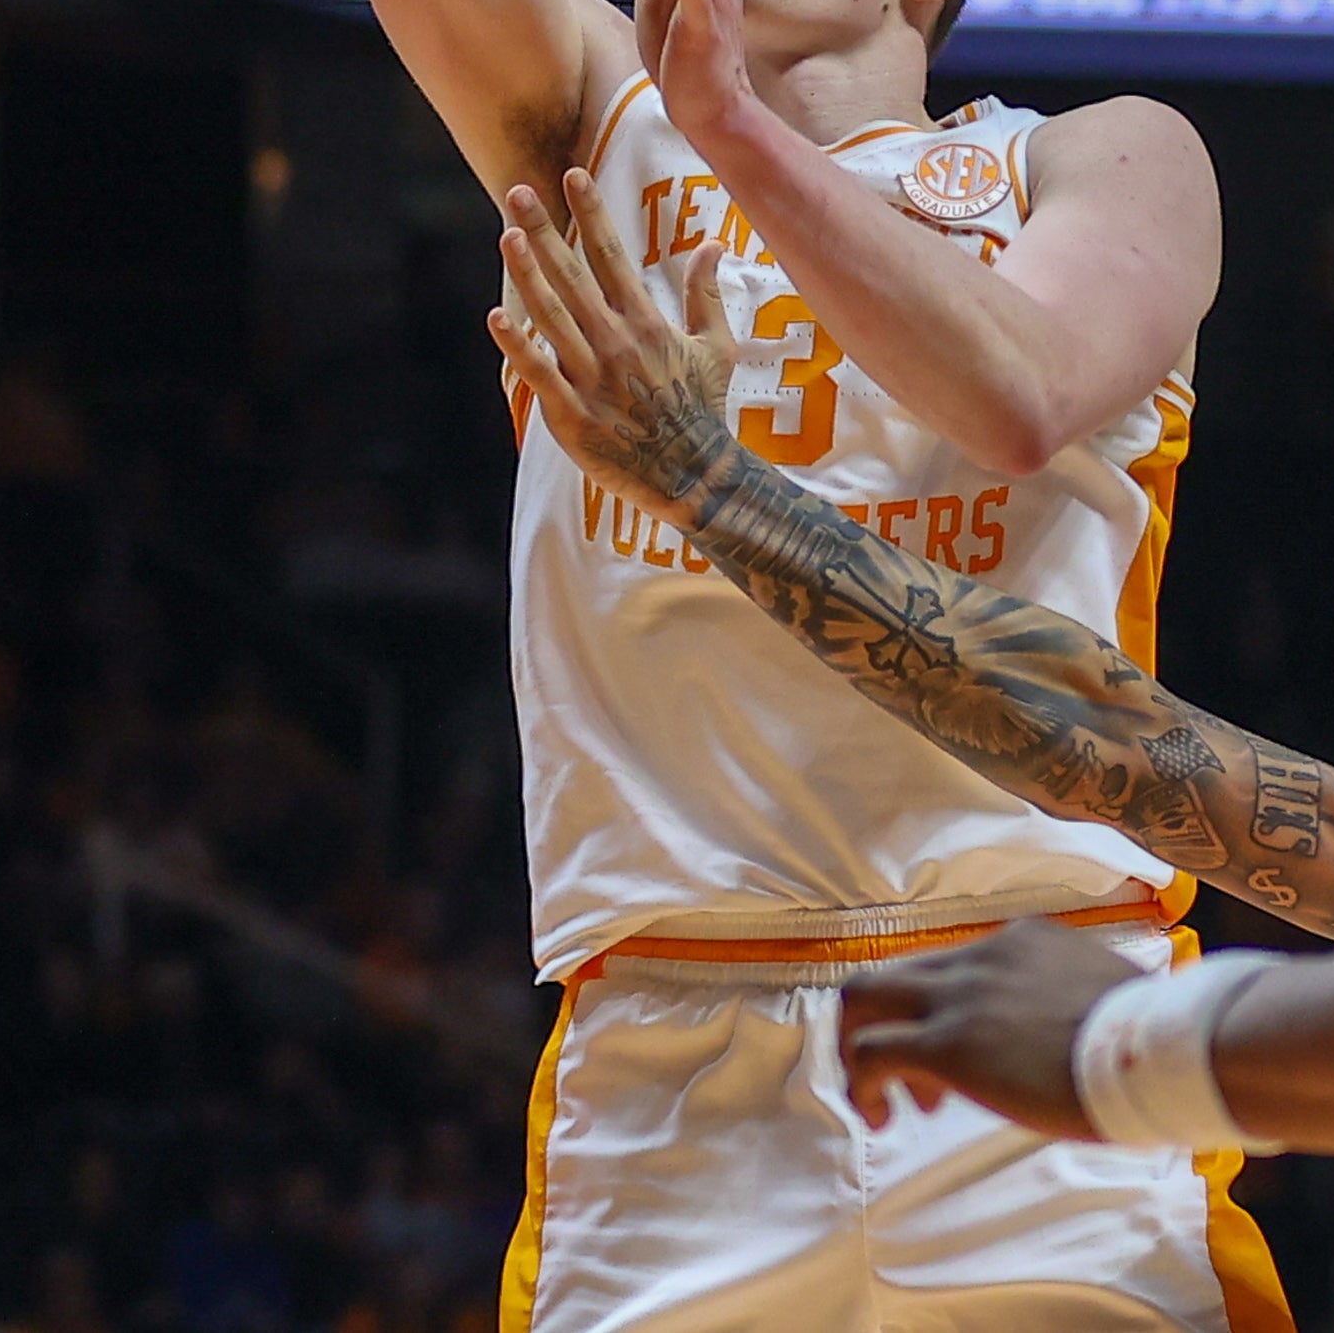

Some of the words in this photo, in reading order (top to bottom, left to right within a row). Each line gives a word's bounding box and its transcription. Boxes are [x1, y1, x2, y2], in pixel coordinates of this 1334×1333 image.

[925, 146, 994, 198] SEC
[909, 186, 997, 218] GRADUATE
[735, 294, 849, 466] 3
